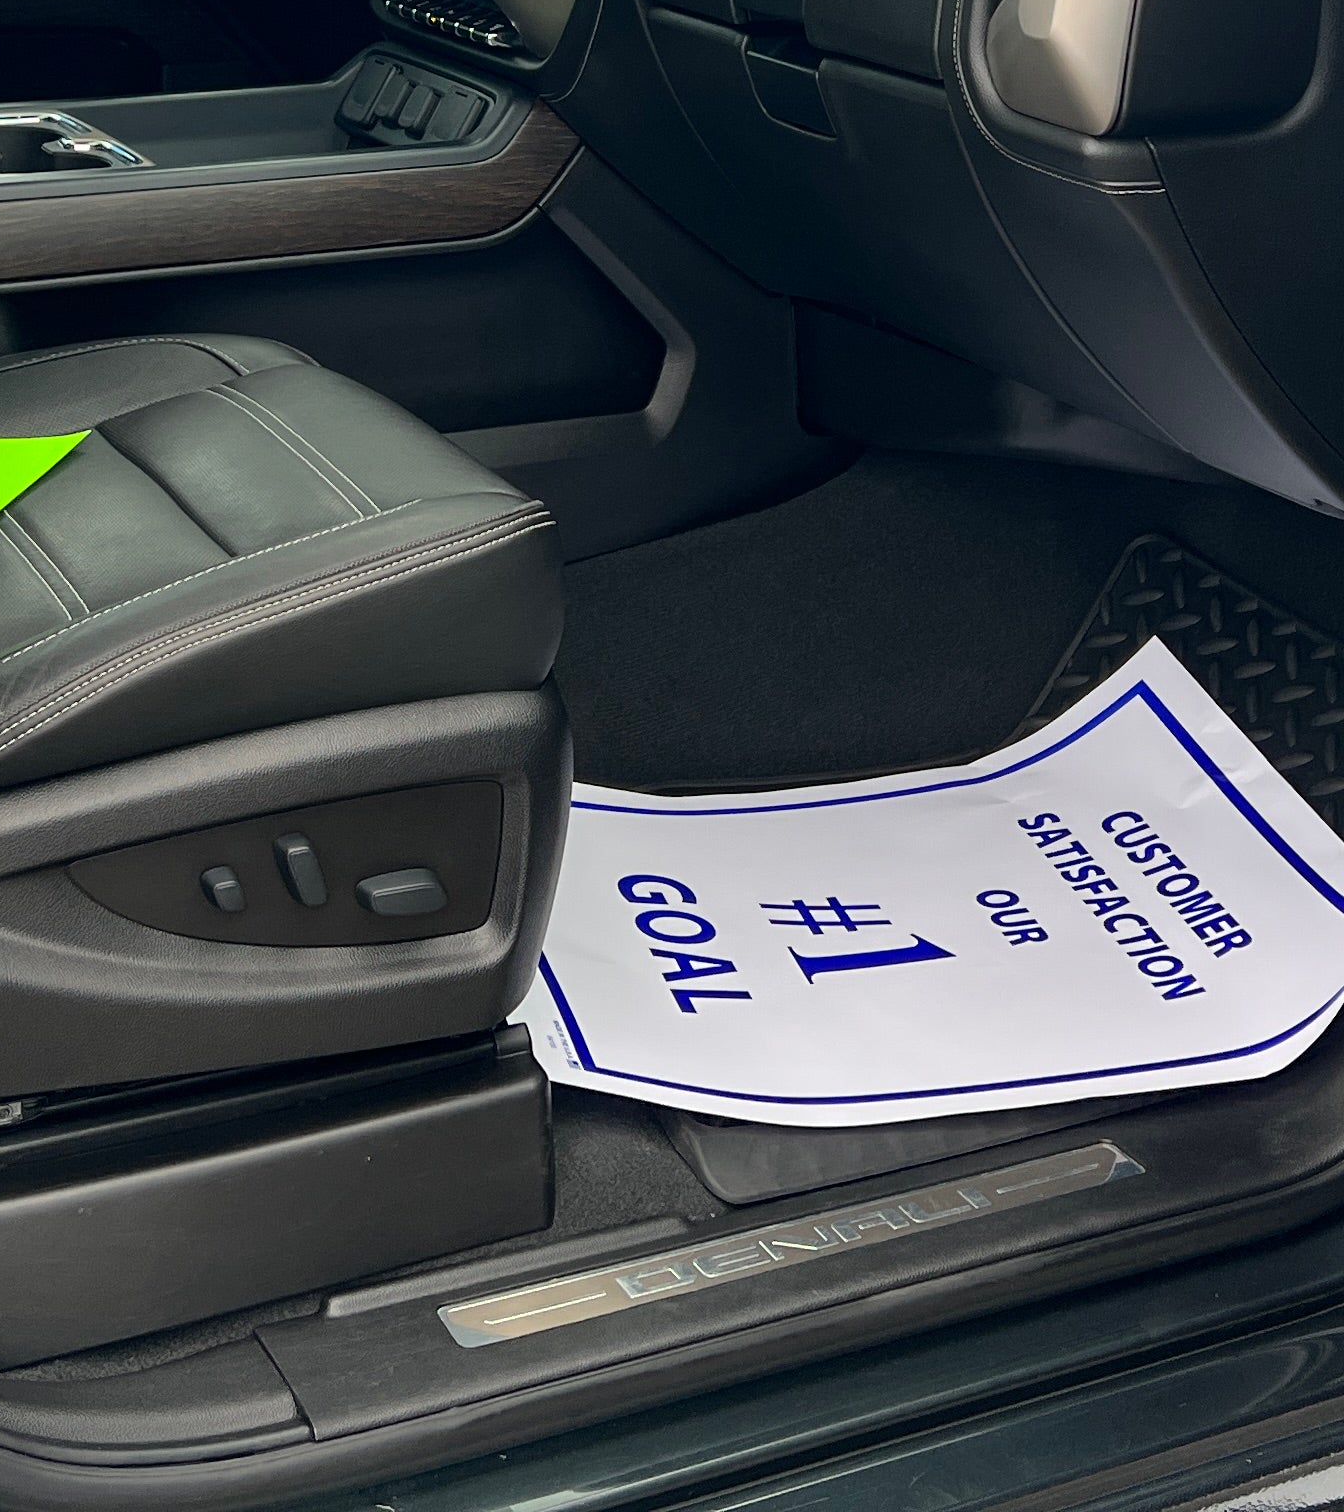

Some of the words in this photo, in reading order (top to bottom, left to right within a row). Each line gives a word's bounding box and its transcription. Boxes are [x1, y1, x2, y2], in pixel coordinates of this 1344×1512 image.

[617, 874, 753, 1014] GOAL
[759, 896, 957, 984] #1
[976, 890, 1049, 945] OUR
[1018, 813, 1205, 1000] SATISFACTION
[1103, 811, 1252, 957] CUSTOMER
[616, 1189, 991, 1299] DENALI
